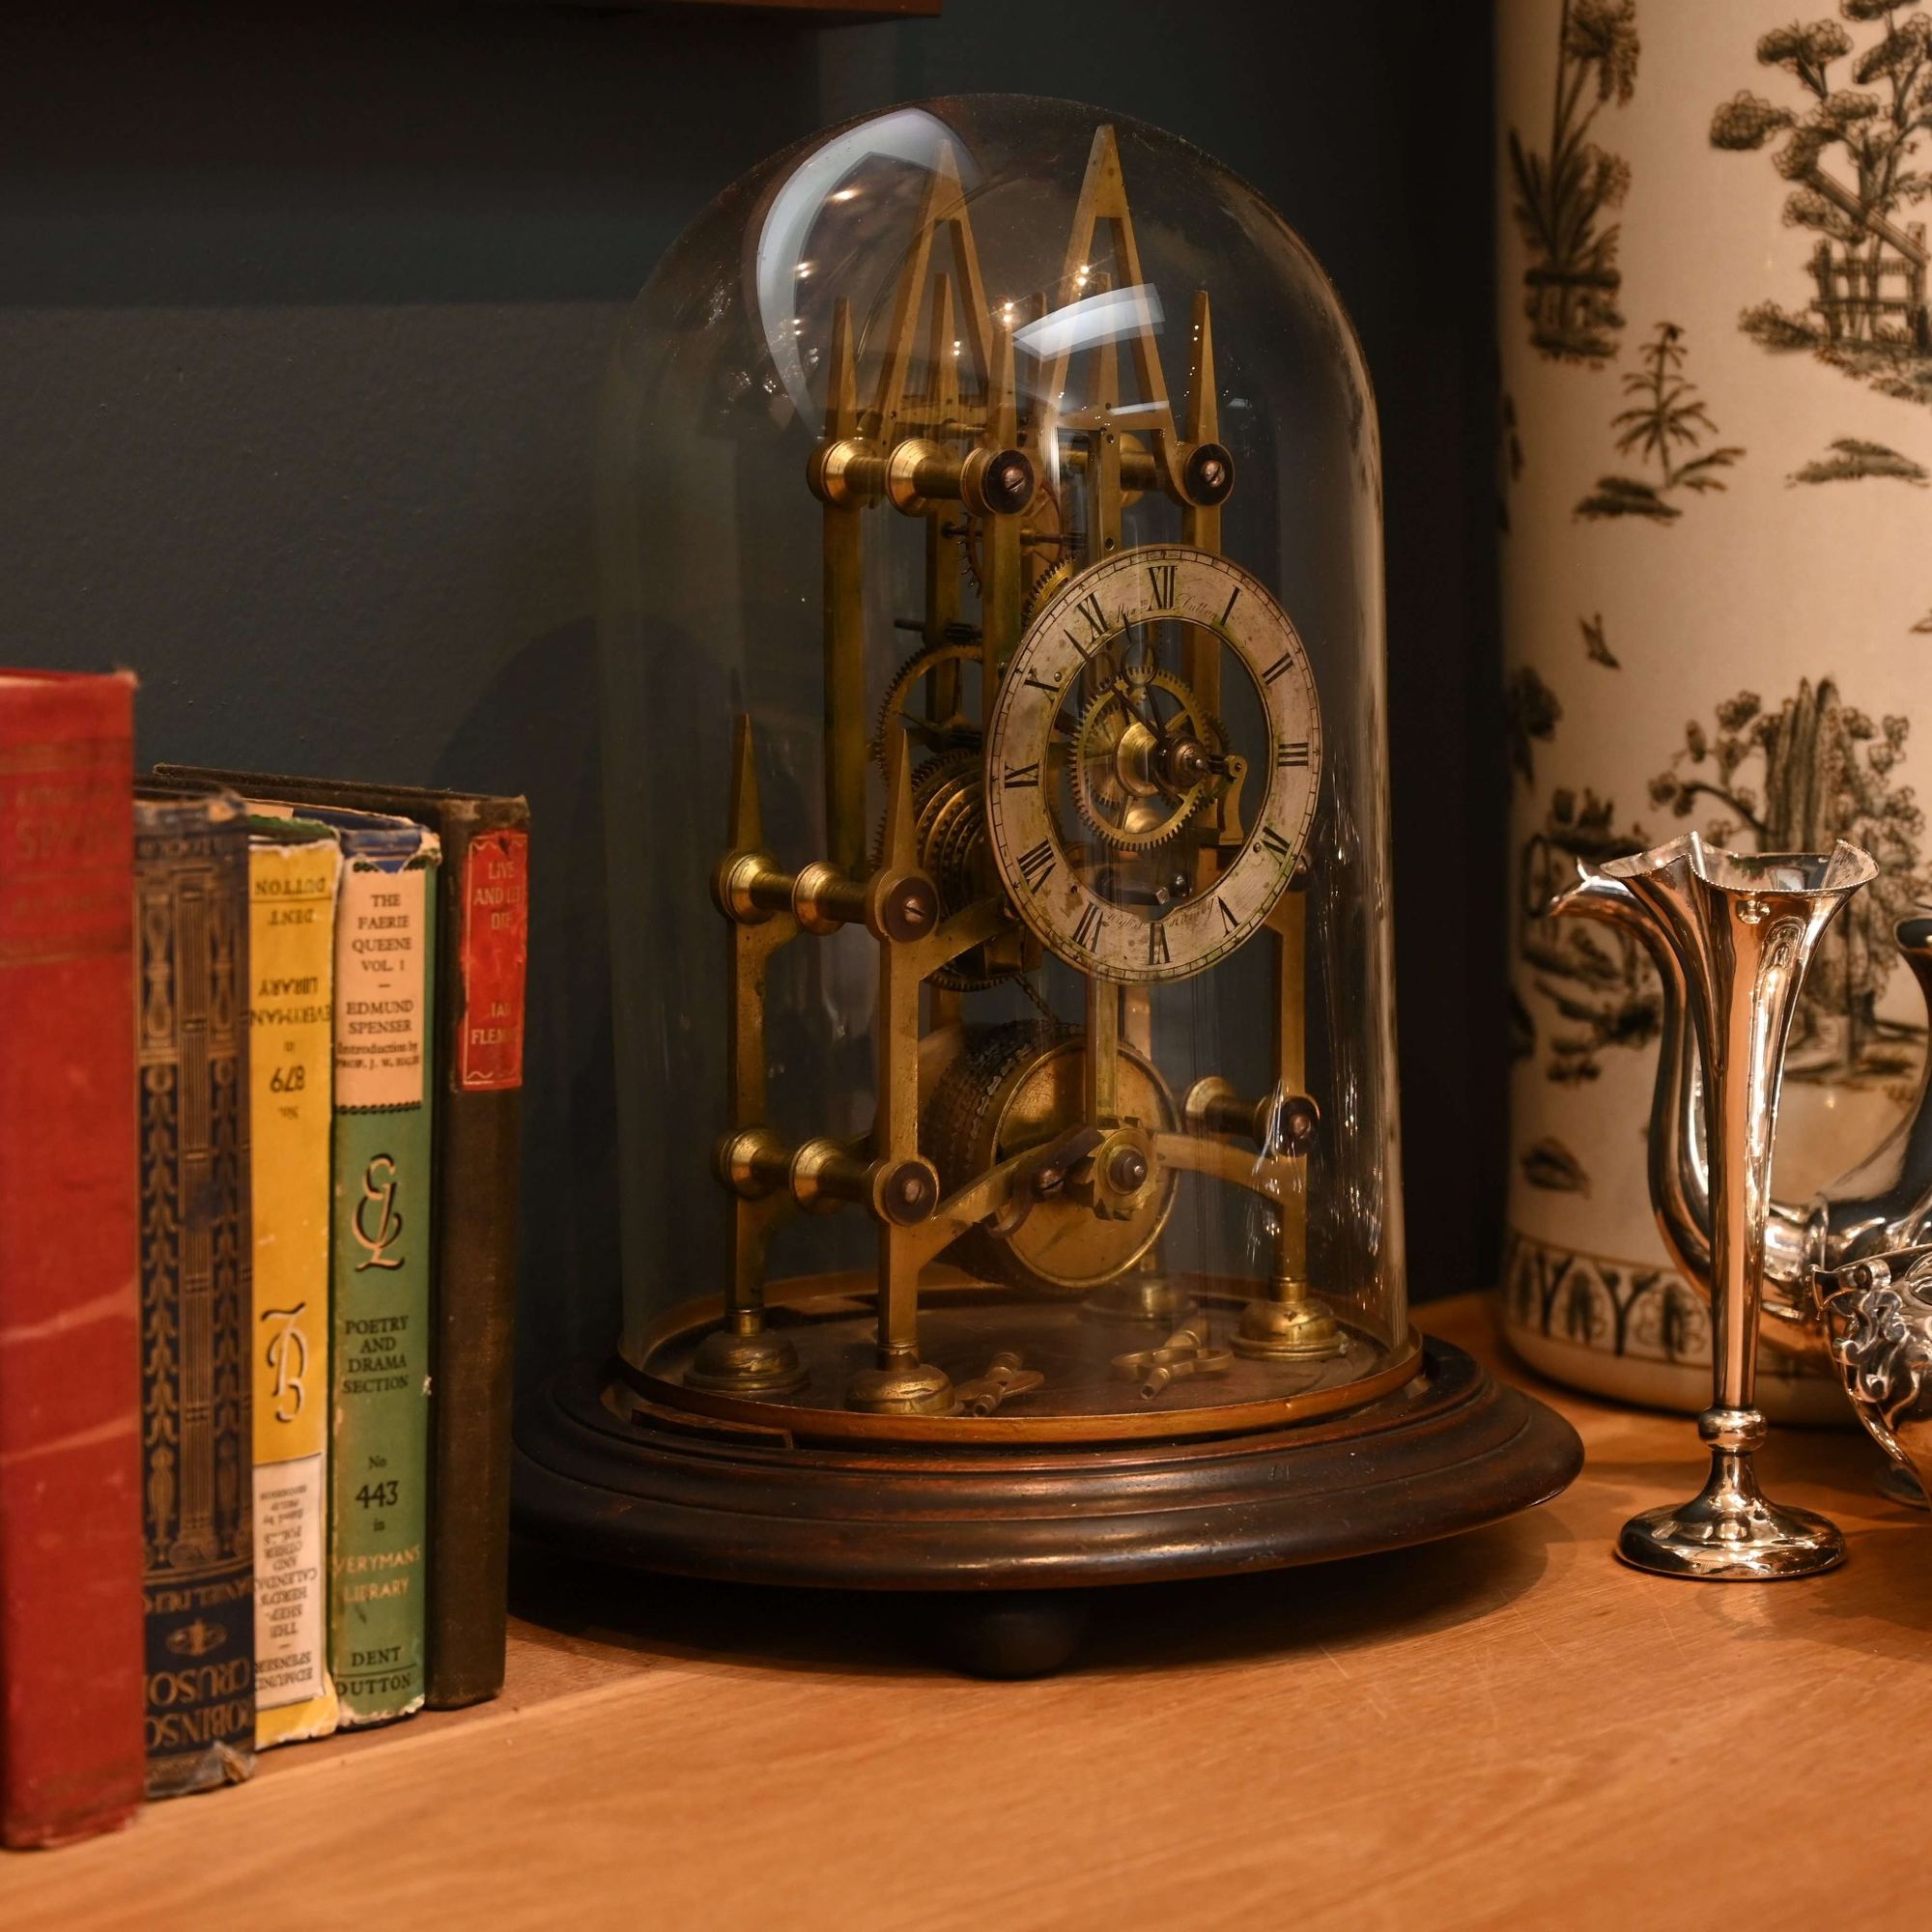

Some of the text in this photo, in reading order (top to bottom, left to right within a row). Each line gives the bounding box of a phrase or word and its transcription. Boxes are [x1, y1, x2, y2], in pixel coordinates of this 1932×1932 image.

[1147, 566, 1179, 611] XII
[1221, 583, 1243, 627] I
[1074, 590, 1110, 645] XI
[1261, 650, 1295, 687] II
[1023, 667, 1061, 705] X
[1276, 741, 1309, 770] III
[1004, 760, 1039, 792] IX
[1260, 826, 1292, 870] IV
[488, 862, 515, 880] LIVE
[1016, 838, 1057, 895] VIII
[254, 876, 326, 895] DUTTON
[370, 894, 401, 907] THE
[473, 888, 503, 906] AND
[268, 908, 314, 925] DENT
[357, 916, 410, 930] FAERIE
[491, 912, 512, 930] DIE
[1216, 895, 1242, 938] V
[1071, 901, 1104, 954] VII
[352, 937, 412, 953] QUEENE
[257, 977, 317, 997] LIBRARY
[346, 1000, 413, 1015] EDMUND
[348, 1019, 412, 1035] SPENSER
[270, 1065, 305, 1094] 879
[345, 1315, 409, 1335] POETRY
[360, 1336, 397, 1353] AND
[348, 1353, 407, 1373] DRAMA
[342, 1375, 409, 1394] SECTION
[355, 1480, 399, 1509] 443
[373, 1518, 385, 1532] in
[272, 1554, 298, 1572] AND
[343, 1577, 410, 1605] LIBRARY
[351, 1645, 402, 1667] DENT
[335, 1672, 412, 1696] DUTTON
